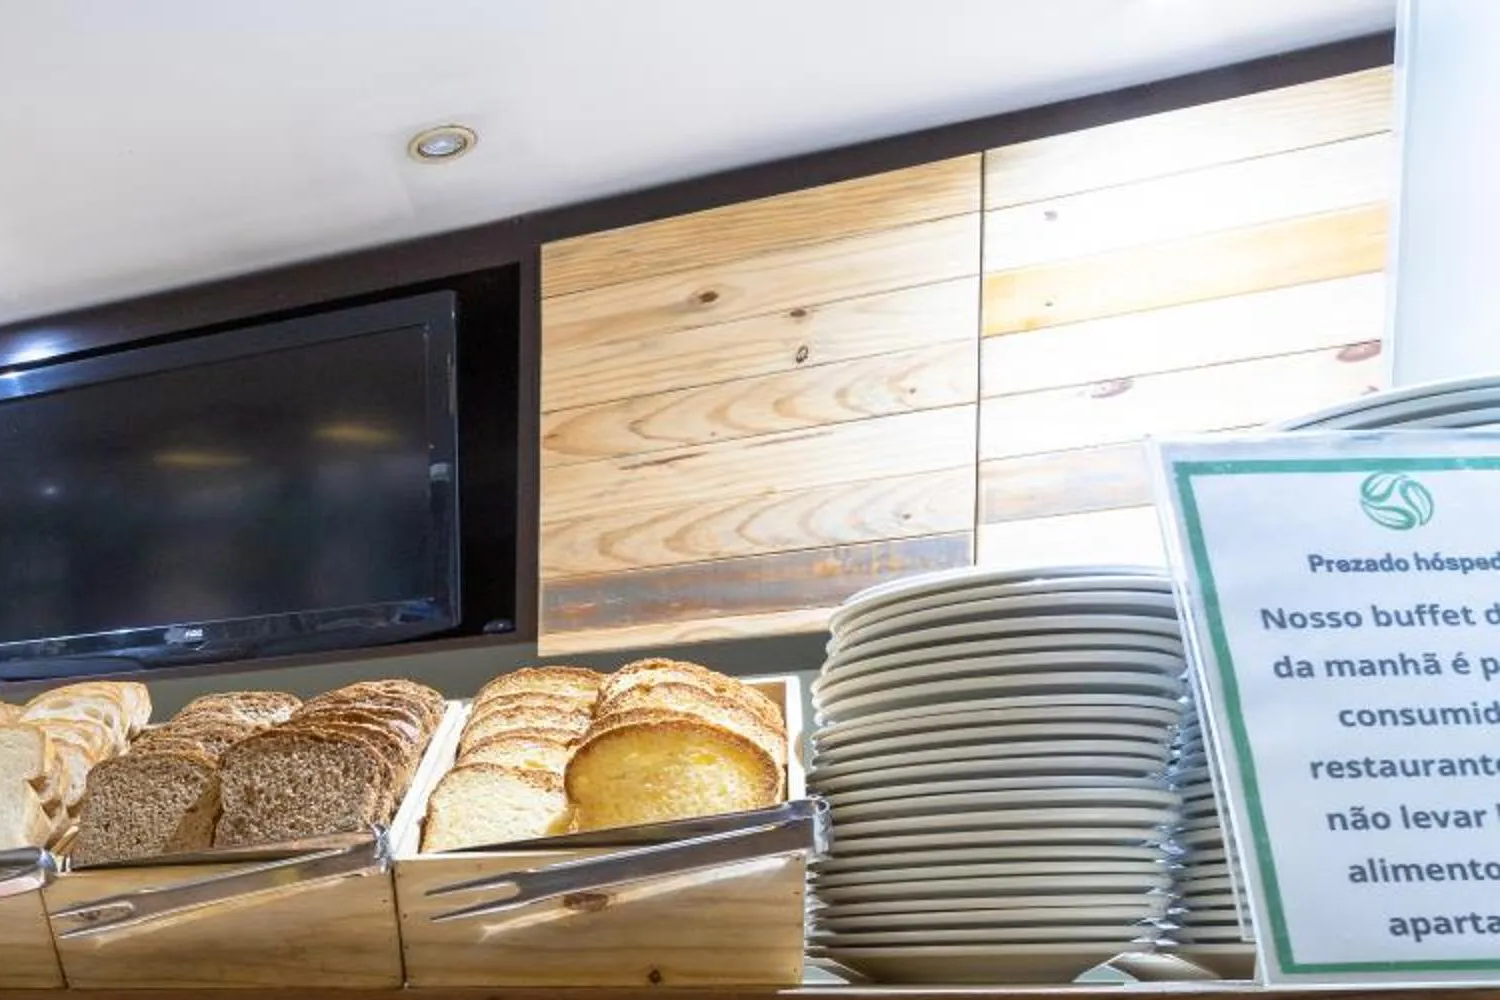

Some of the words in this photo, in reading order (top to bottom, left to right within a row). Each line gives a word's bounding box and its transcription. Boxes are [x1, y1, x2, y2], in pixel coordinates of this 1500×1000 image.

[1307, 552, 1409, 573] Prezado
[1260, 607, 1363, 630] Nosso
[1370, 603, 1477, 627] buffet
[1273, 655, 1315, 679] da
[1324, 651, 1443, 677] manhã
[1451, 651, 1471, 675] é
[1338, 700, 1500, 728] consumid
[1309, 754, 1500, 780] restaurant
[1326, 806, 1391, 831] não
[1400, 804, 1487, 829] levar
[1348, 857, 1500, 883] alimento
[1389, 911, 1500, 943] aparta
